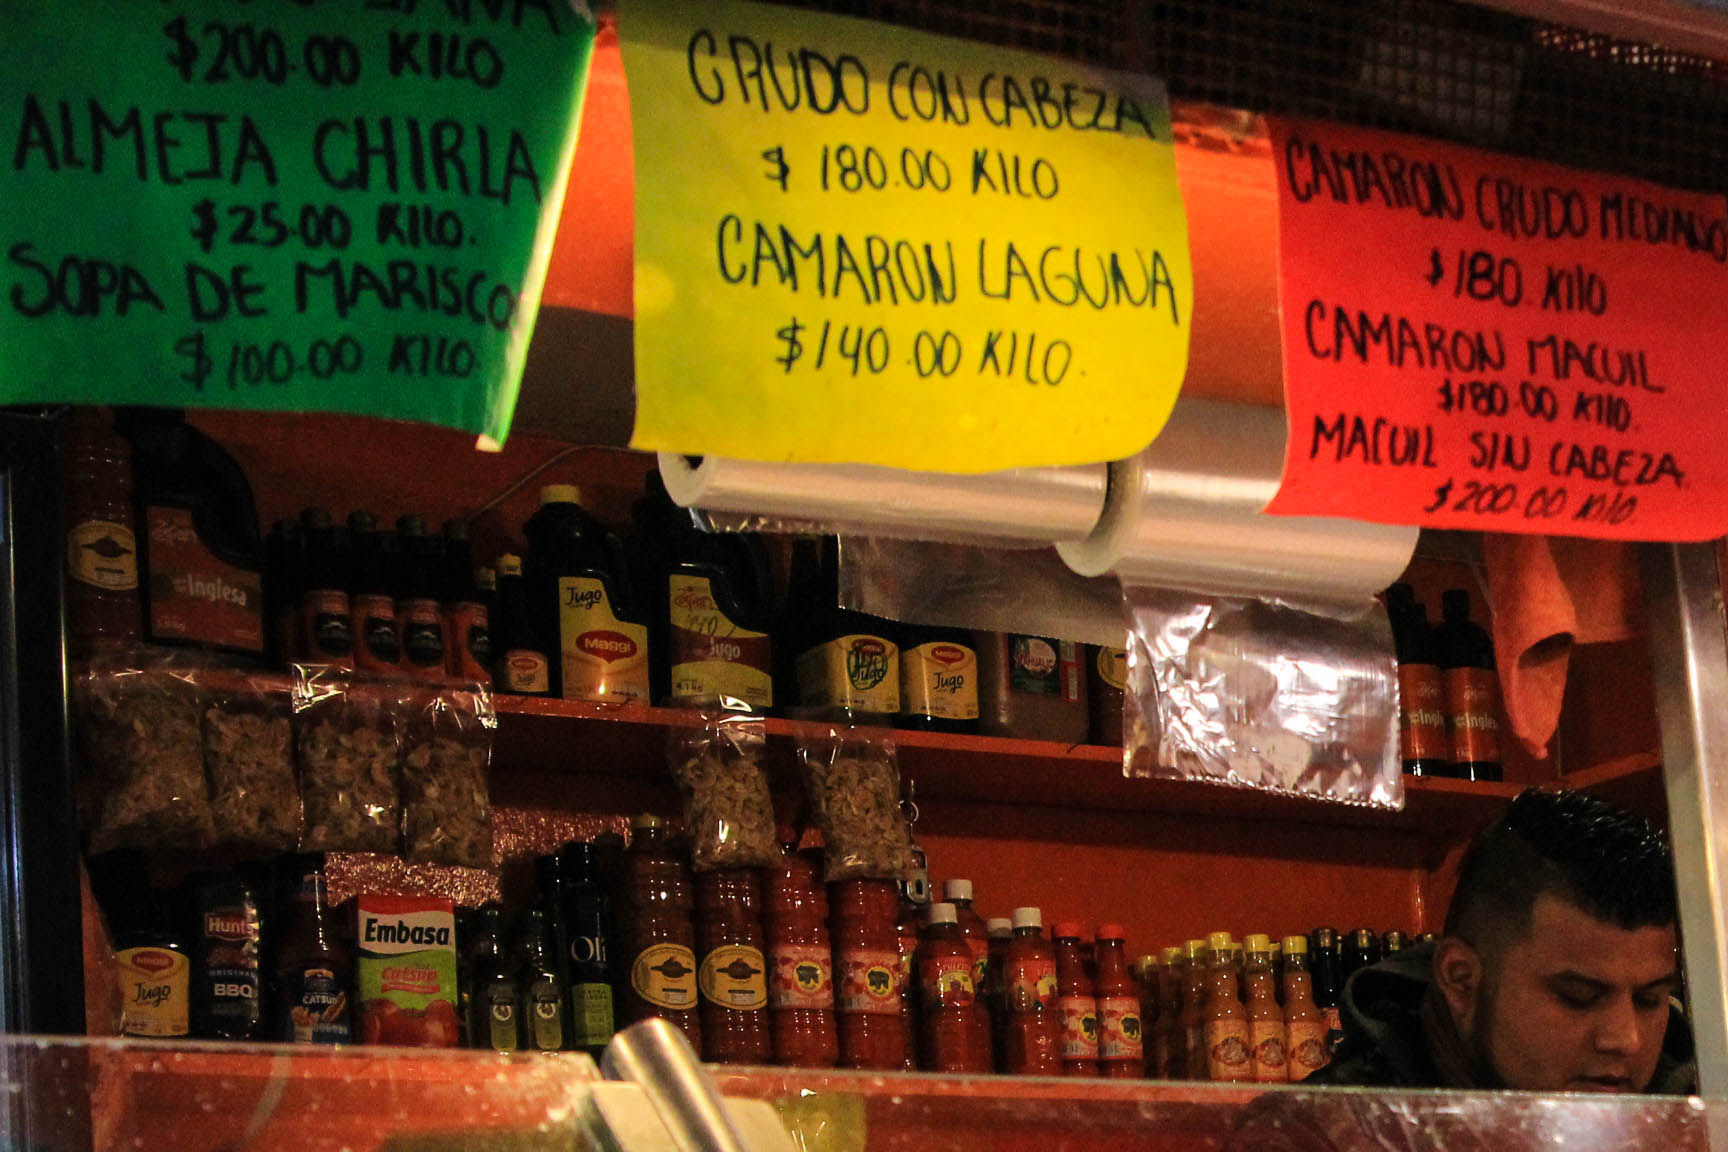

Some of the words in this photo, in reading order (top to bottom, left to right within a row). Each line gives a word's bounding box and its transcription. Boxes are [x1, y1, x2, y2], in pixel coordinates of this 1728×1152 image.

[165, 16, 361, 87] $200.00
[389, 31, 502, 88] KILO
[689, 29, 868, 115] CRUDO
[889, 62, 969, 125] CON
[980, 72, 1155, 139] CABEZA
[14, 94, 277, 185] ALMEJA
[312, 114, 542, 205] CHIRLA
[971, 149, 1059, 199] KILO
[1285, 136, 1464, 220] CAMARON
[1475, 174, 1589, 240] CRUDO
[192, 198, 351, 252] $25.00
[9, 242, 165, 317] SOPA
[185, 264, 267, 322] DE
[295, 259, 517, 330] MARISCO
[717, 213, 957, 306] CAMARON
[979, 236, 1179, 325] LAGUNA
[1305, 300, 1506, 373] CAMARON
[1527, 335, 1664, 394] MACUIL
[1310, 413, 1437, 468] MACUIL
[1470, 431, 1530, 472] SIN
[565, 586, 603, 609] Jugo
[933, 672, 965, 693] Jugo
[365, 918, 449, 945] Embasa
[132, 982, 171, 1009] Jugo
[214, 983, 254, 999] BBQ
